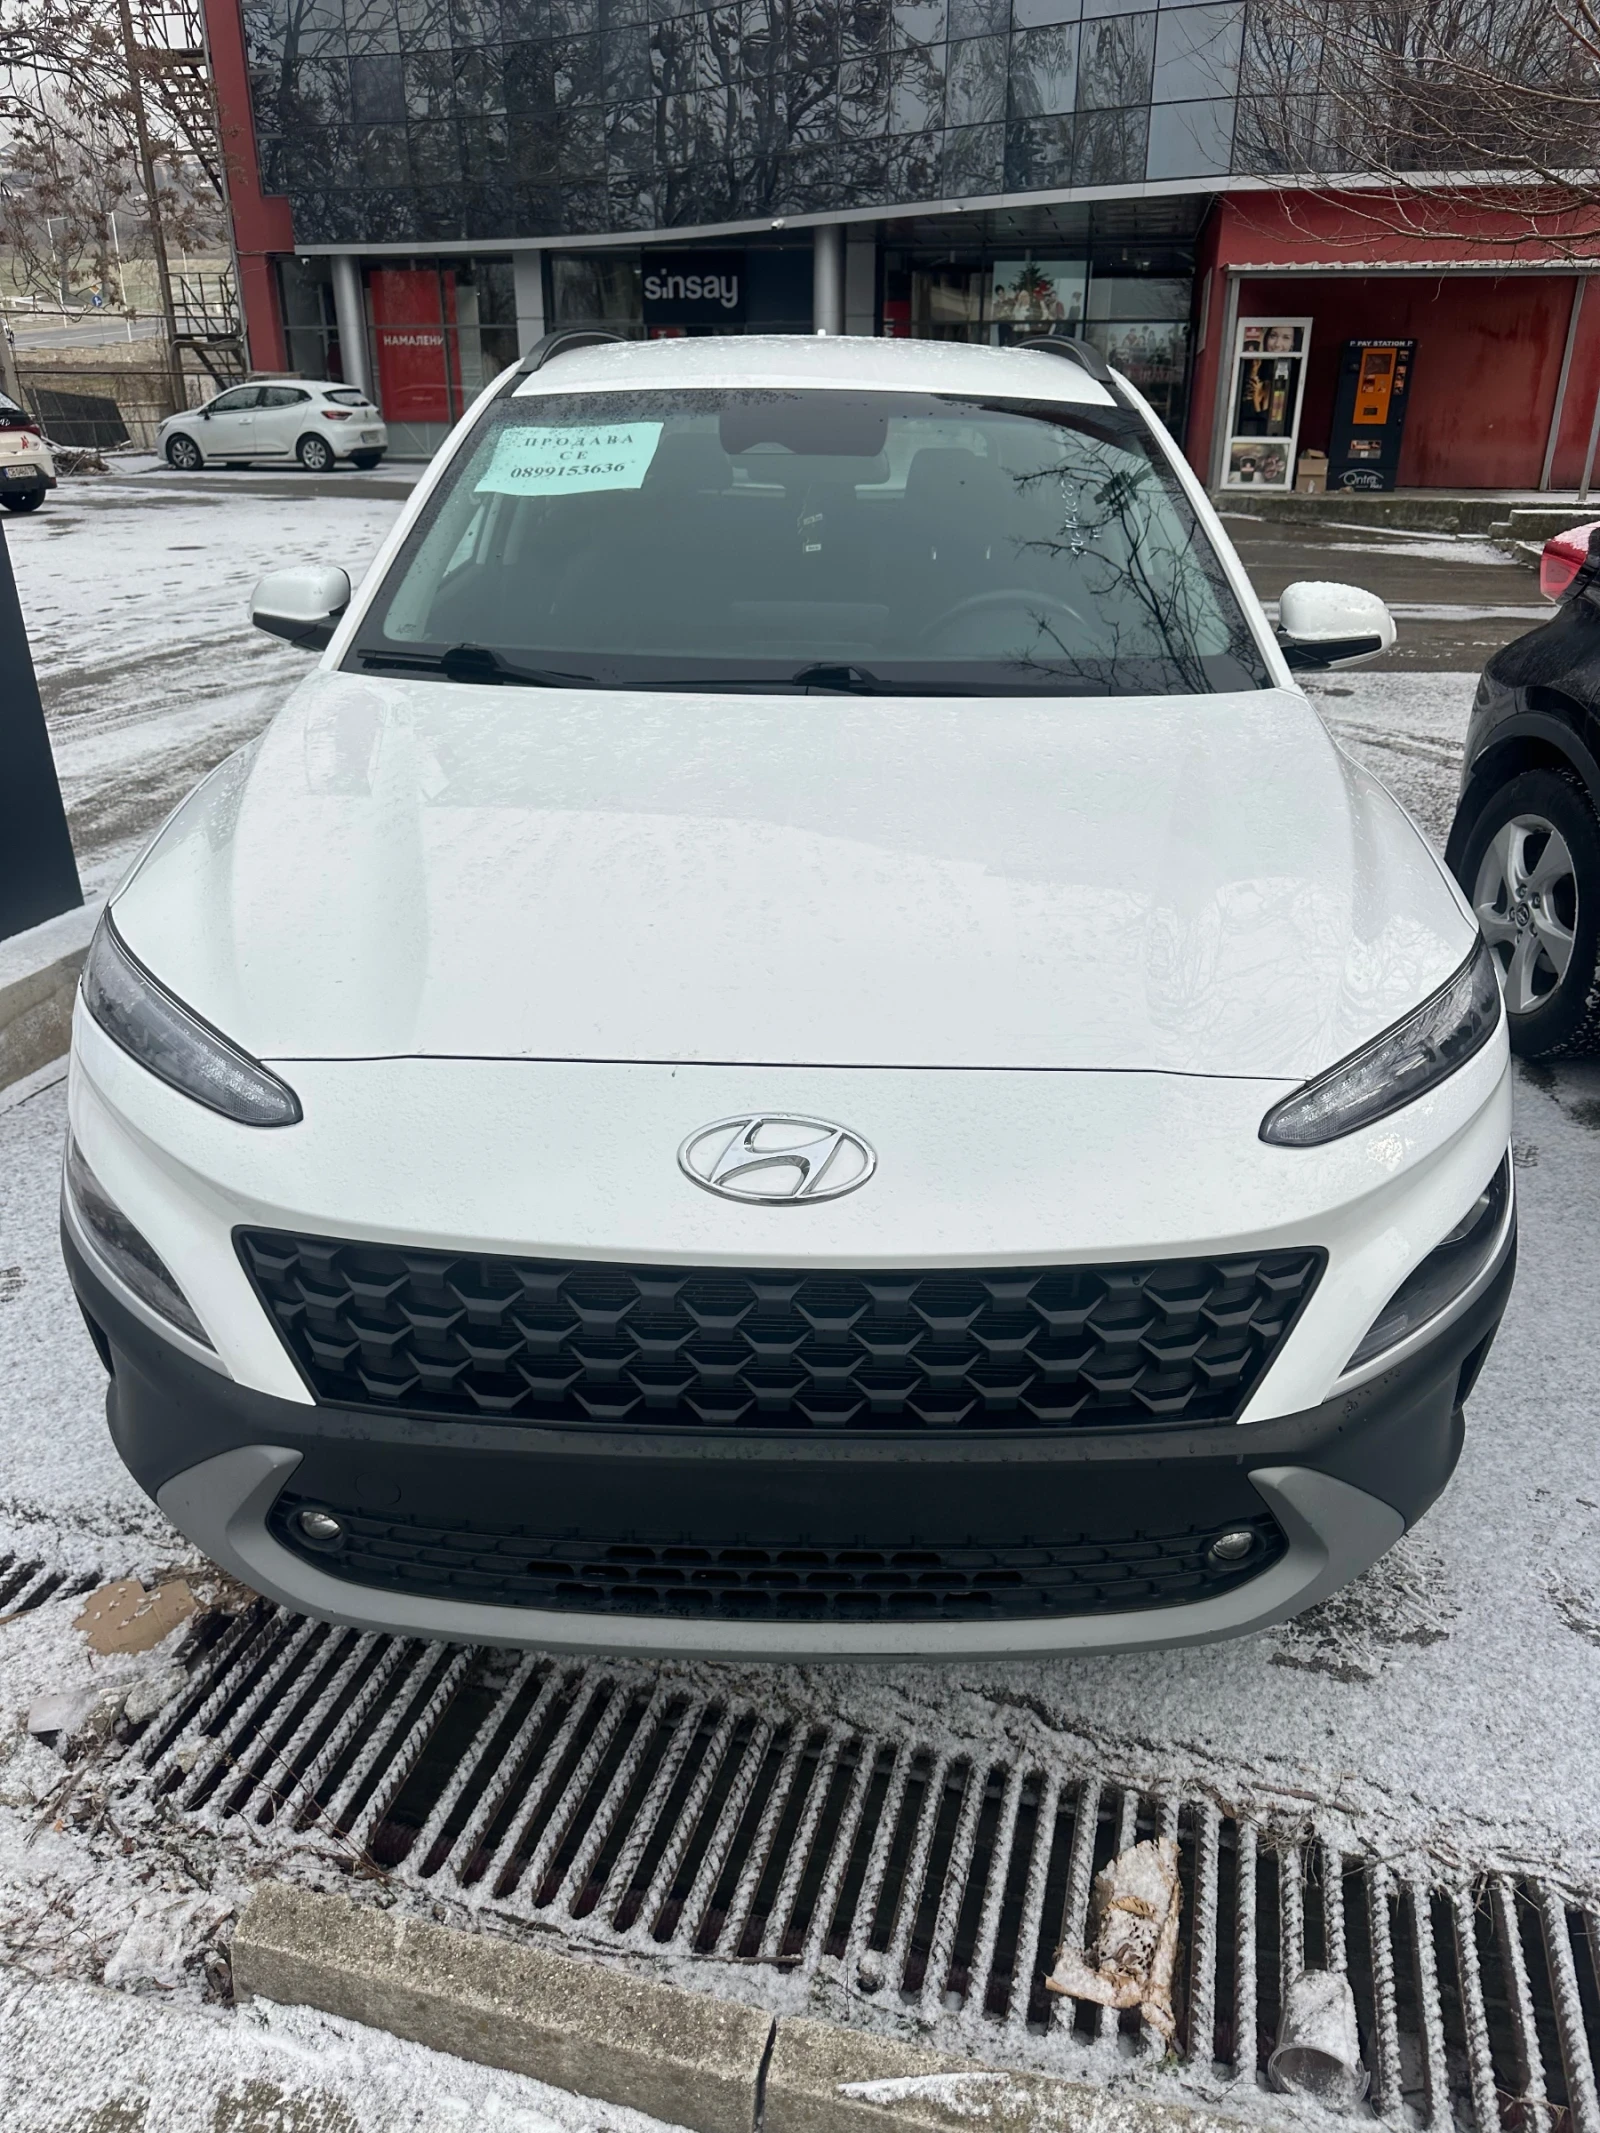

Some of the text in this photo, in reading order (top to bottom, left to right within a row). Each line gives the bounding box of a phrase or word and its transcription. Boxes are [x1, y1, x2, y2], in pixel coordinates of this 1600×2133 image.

[644, 268, 738, 308] sinsay
[524, 434, 634, 448] ПРОДАВА
[559, 450, 589, 461] СЕ
[510, 463, 625, 478] 0899153636
